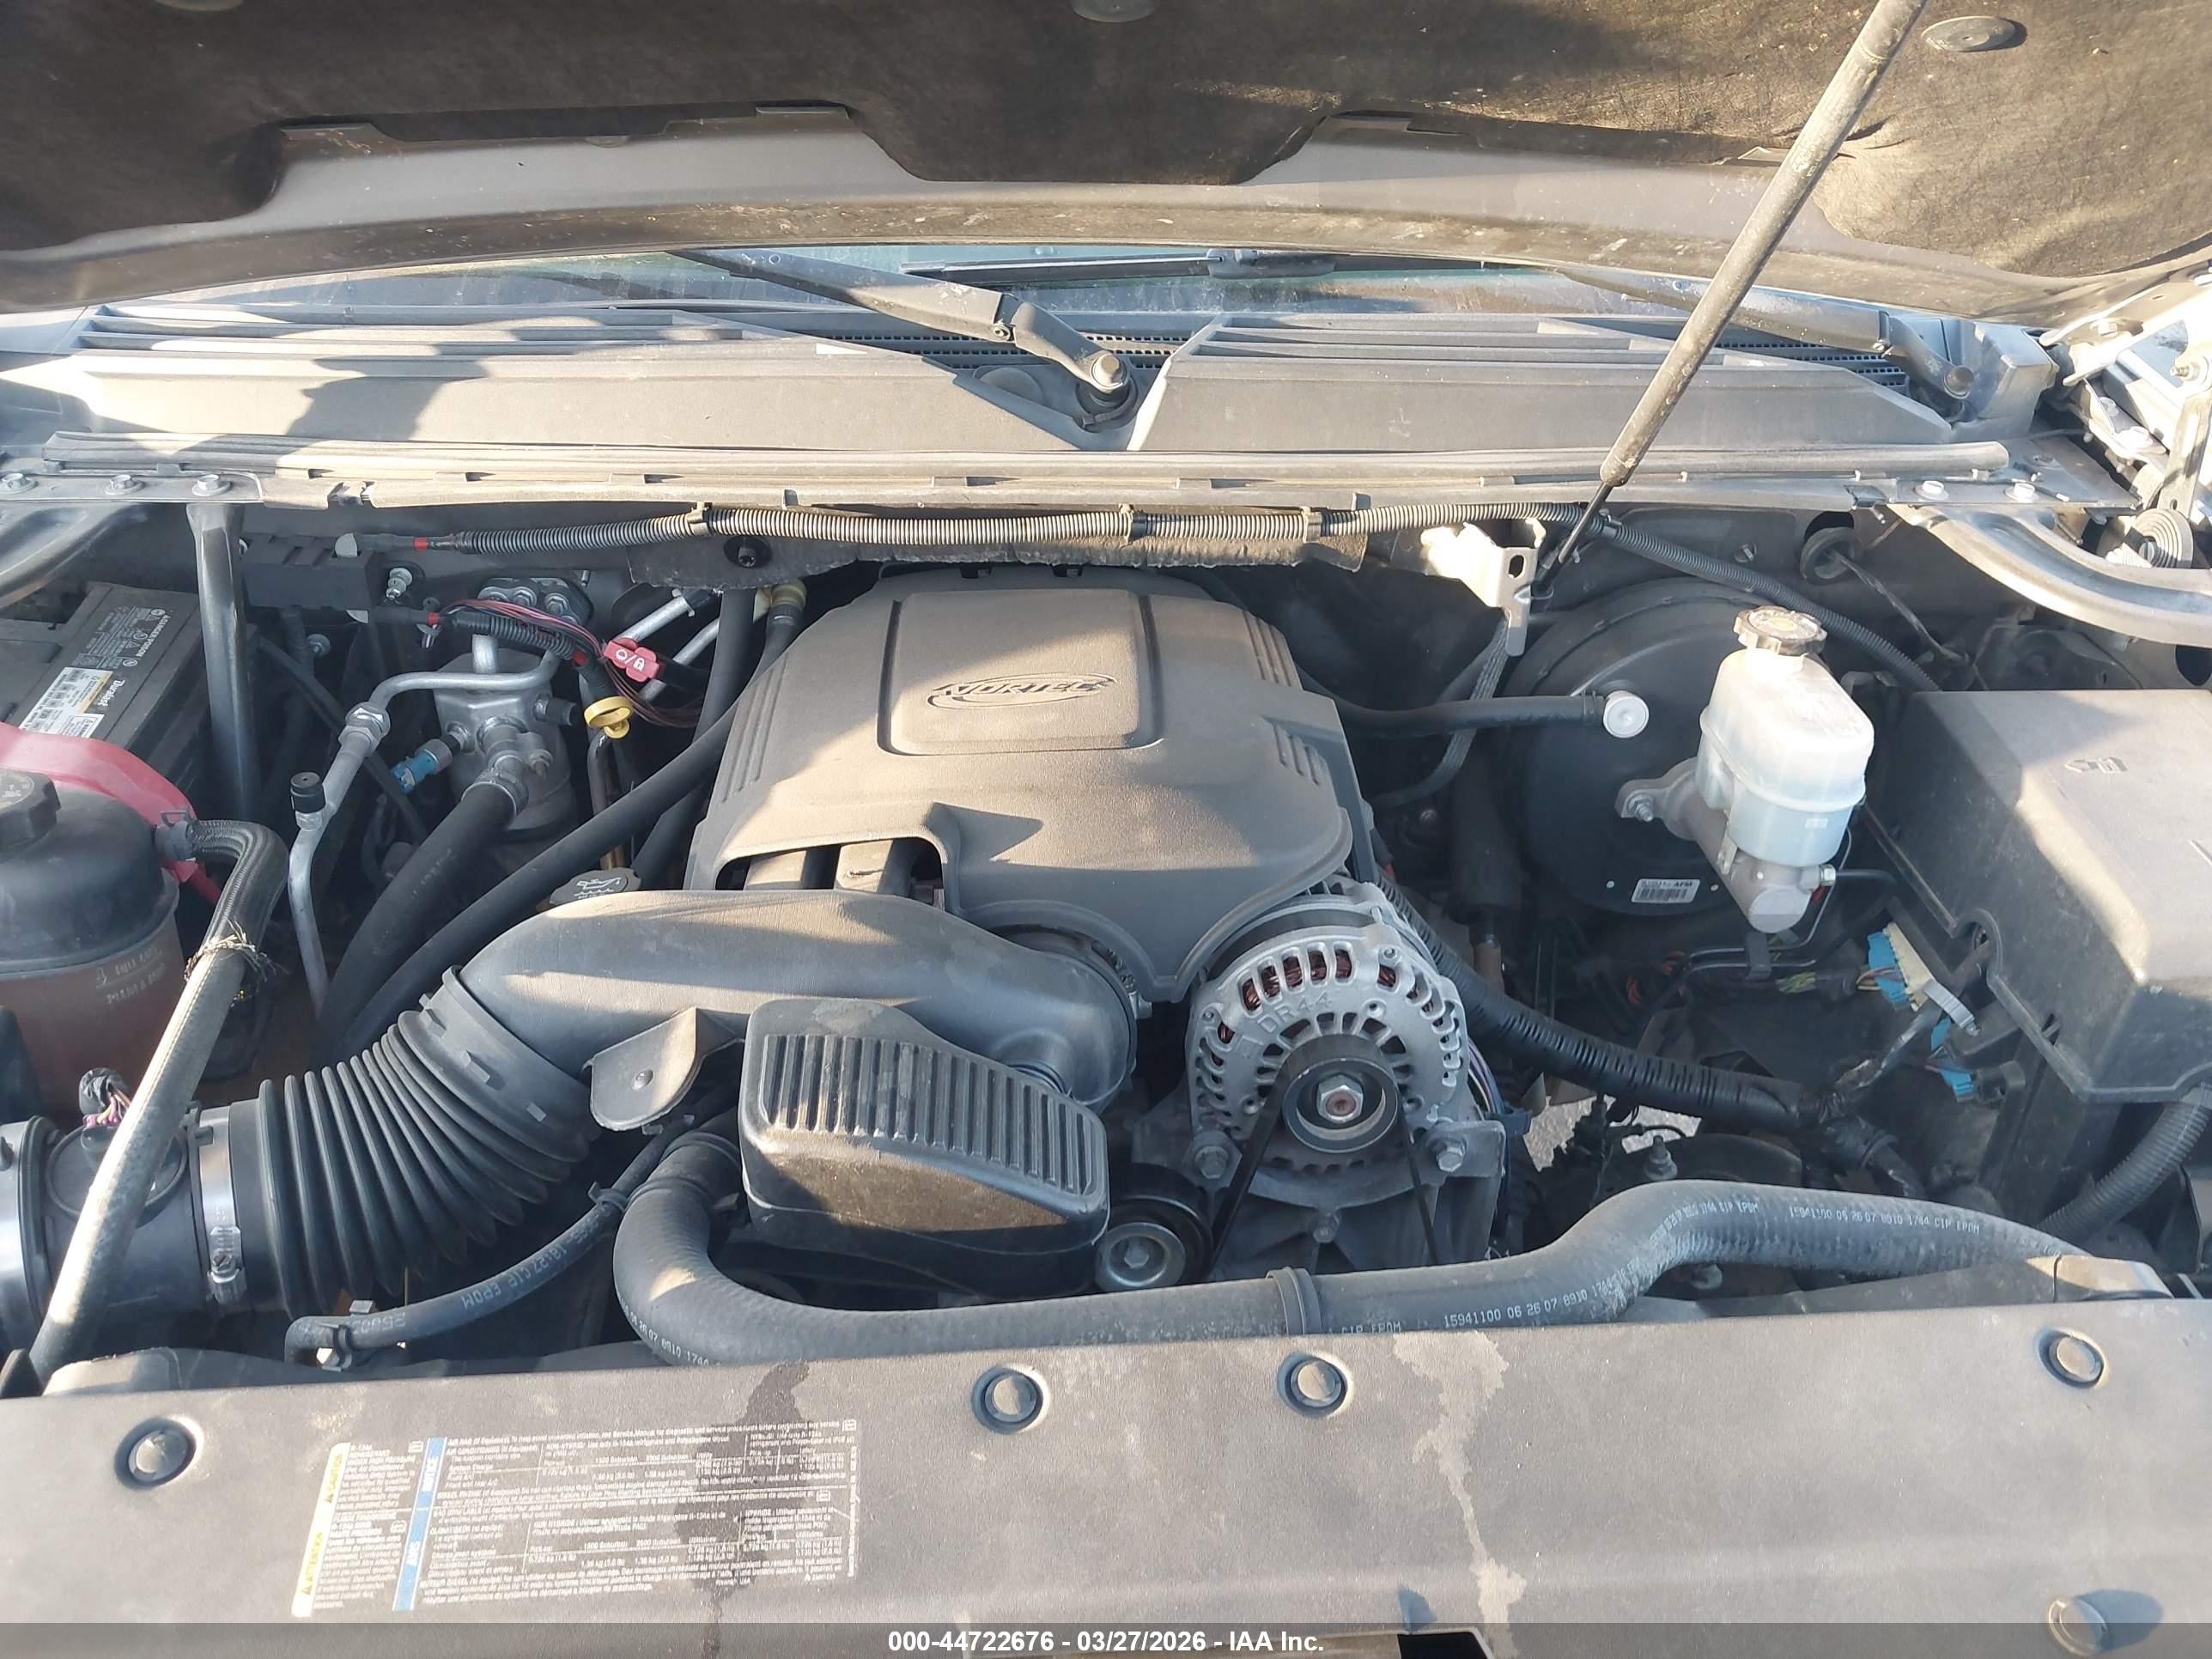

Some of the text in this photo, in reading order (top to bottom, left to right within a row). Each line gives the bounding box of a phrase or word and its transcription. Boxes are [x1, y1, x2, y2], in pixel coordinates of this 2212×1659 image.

[98, 680, 125, 707] Duralast
[461, 1282, 502, 1310] EPDM
[1443, 1308, 1501, 1329] 15941100
[1507, 1306, 1522, 1319] 06
[1526, 1302, 1541, 1316] 26
[1544, 1297, 1558, 1313] 07
[1563, 1288, 1588, 1308] 8910
[421, 1455, 440, 1492] NOTICE
